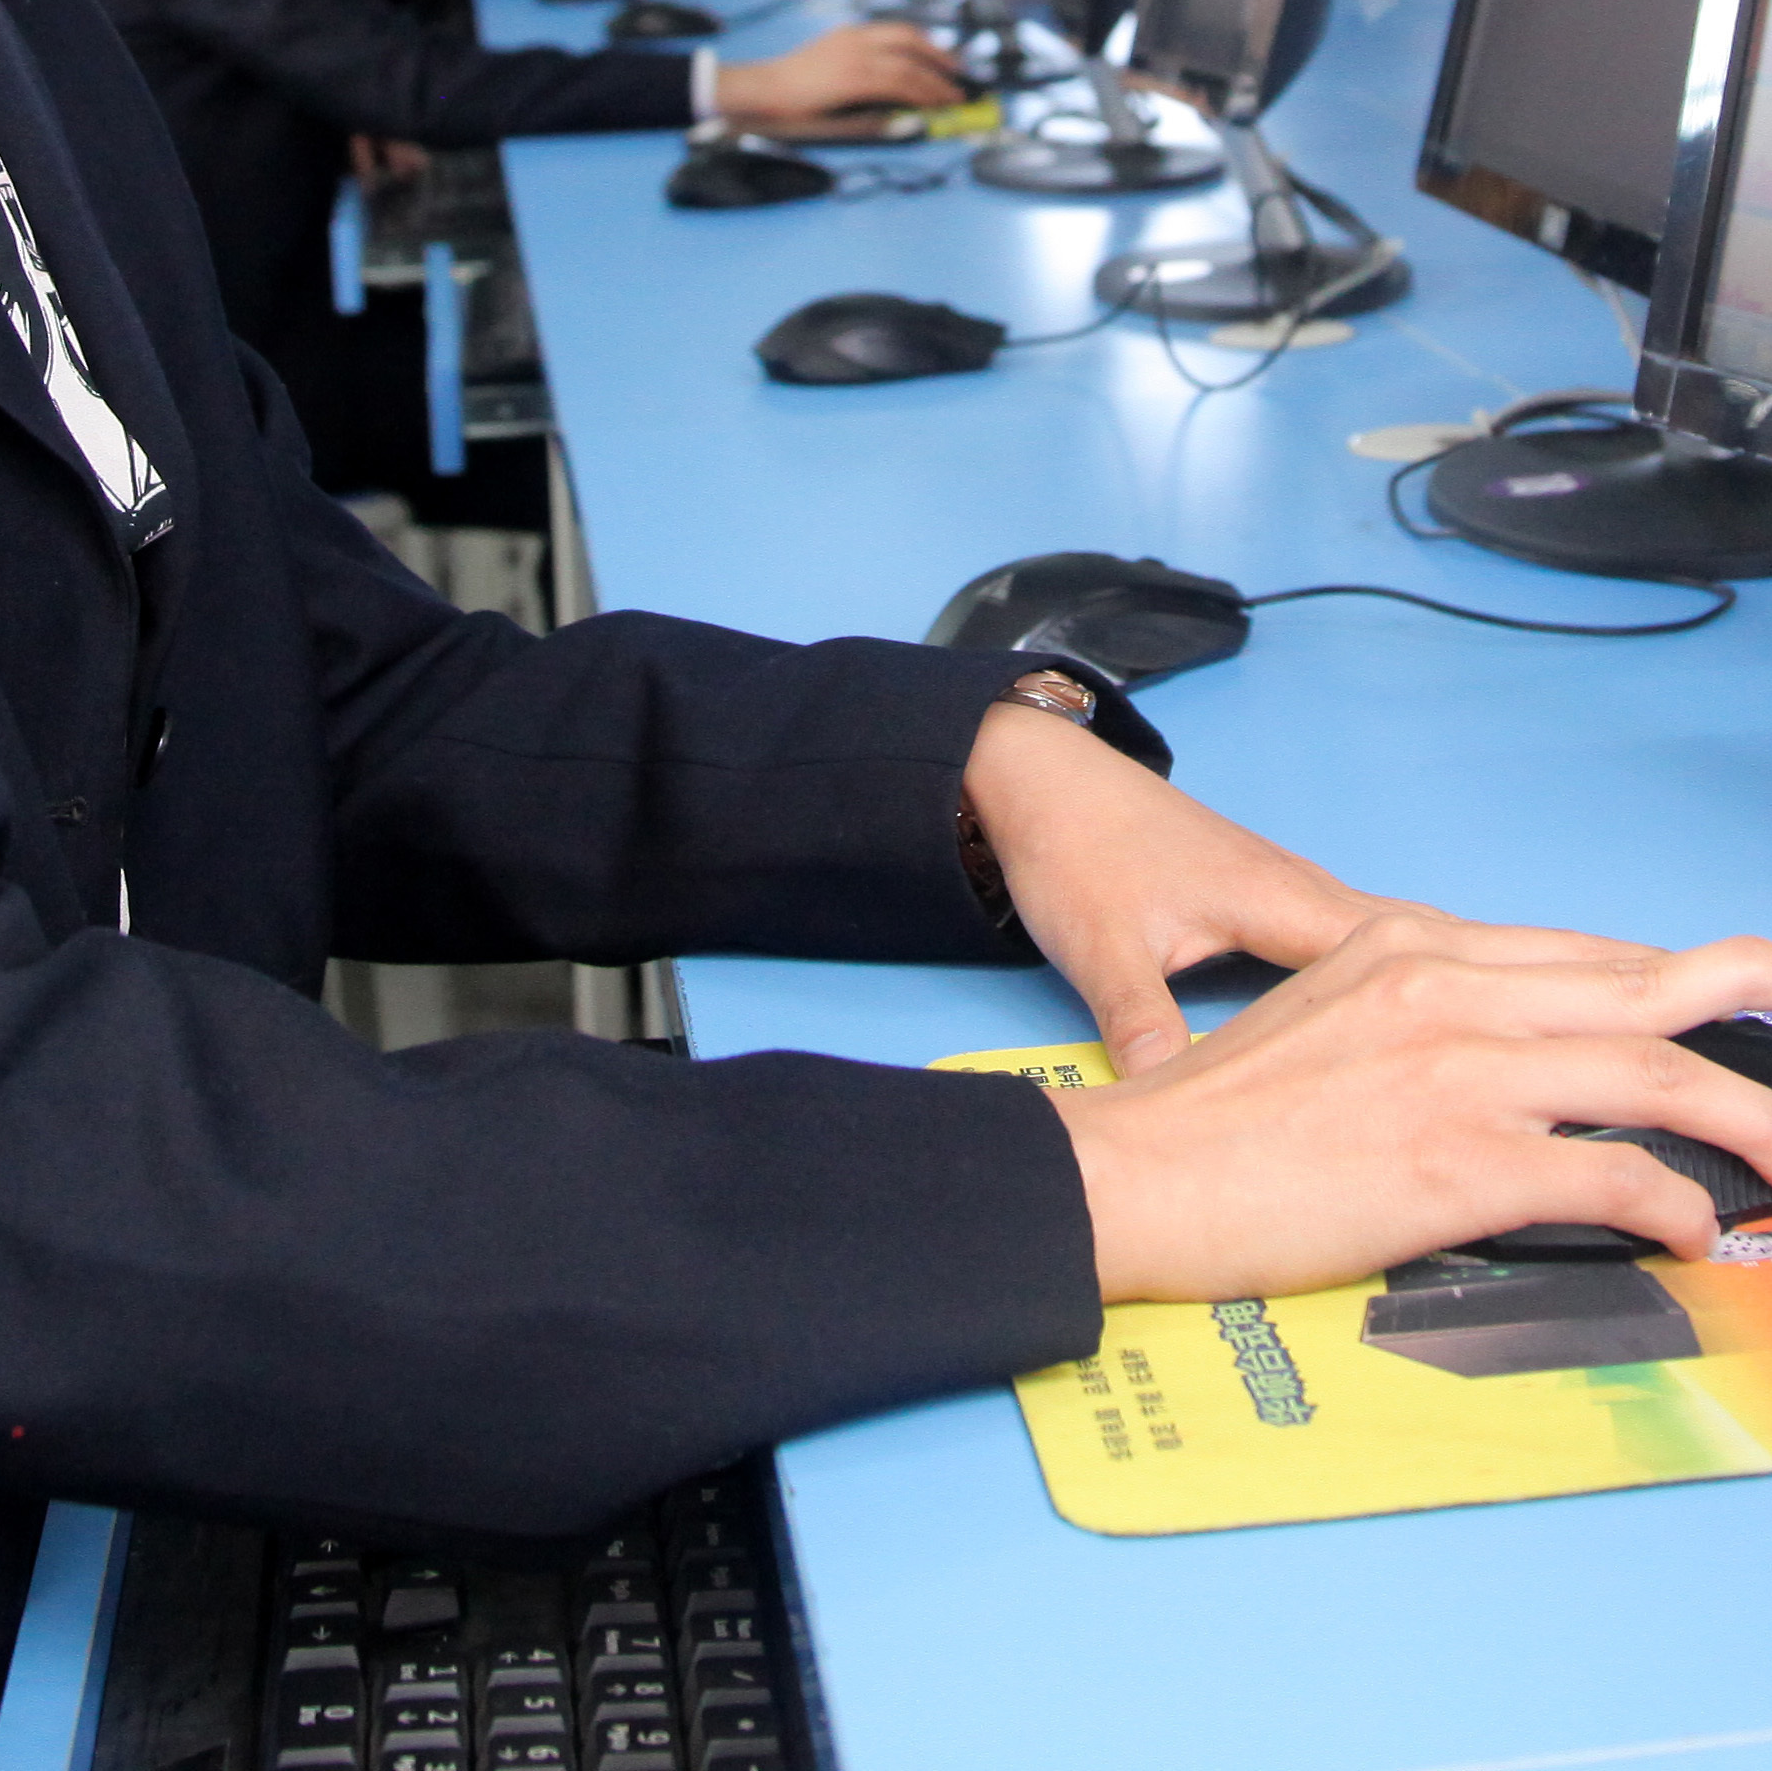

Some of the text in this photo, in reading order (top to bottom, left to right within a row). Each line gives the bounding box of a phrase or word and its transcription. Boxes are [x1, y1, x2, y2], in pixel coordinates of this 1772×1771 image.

[631, 1636, 661, 1649] 7
[529, 1648, 556, 1662] 4
[428, 1664, 459, 1675] 1
[634, 1682, 665, 1696] 8
[523, 1695, 556, 1710] 5
[324, 1704, 356, 1721] 0
[428, 1708, 459, 1724] 2
[636, 1728, 670, 1746] 9
[526, 1743, 561, 1760] 6
